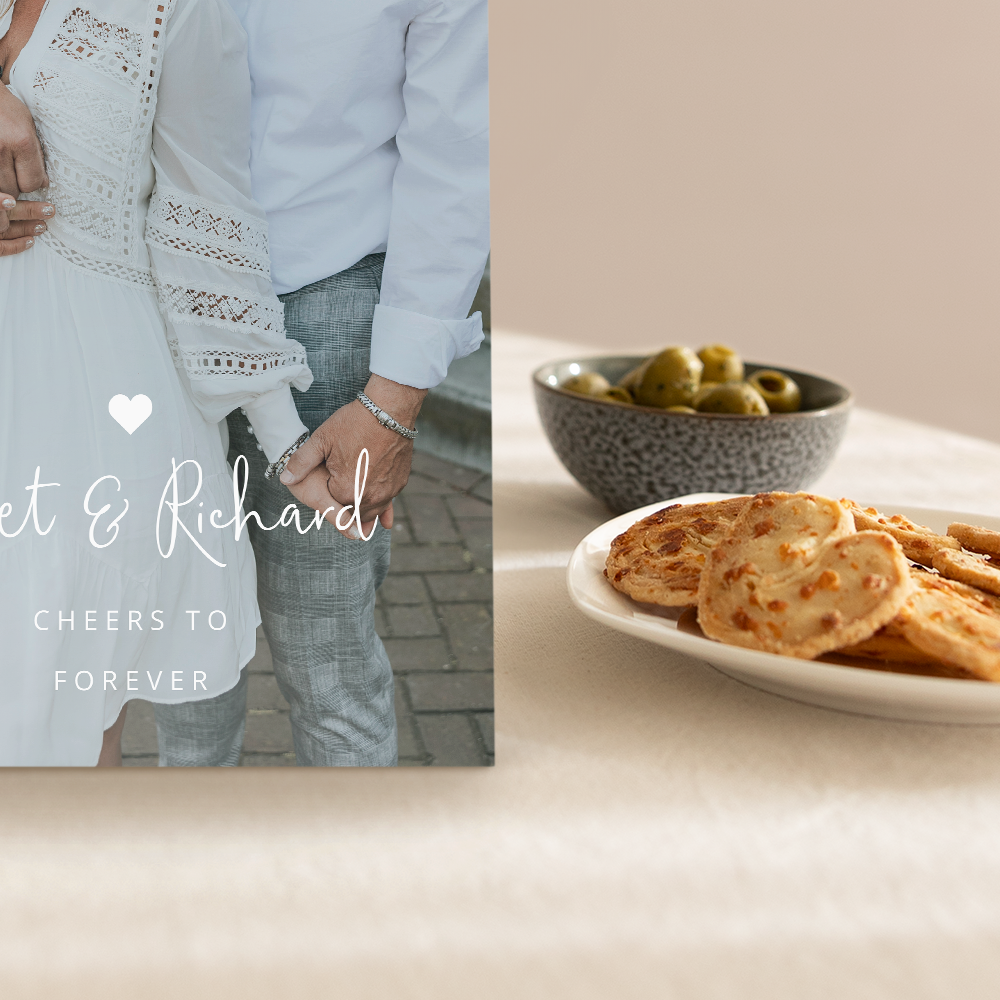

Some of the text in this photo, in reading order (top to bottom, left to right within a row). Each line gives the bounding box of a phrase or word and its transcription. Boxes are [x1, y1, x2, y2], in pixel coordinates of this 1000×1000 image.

[83, 475, 129, 548] &
[155, 448, 379, 567] Richard
[33, 609, 228, 631] CHEERS TO
[54, 669, 209, 691] FOREVER
